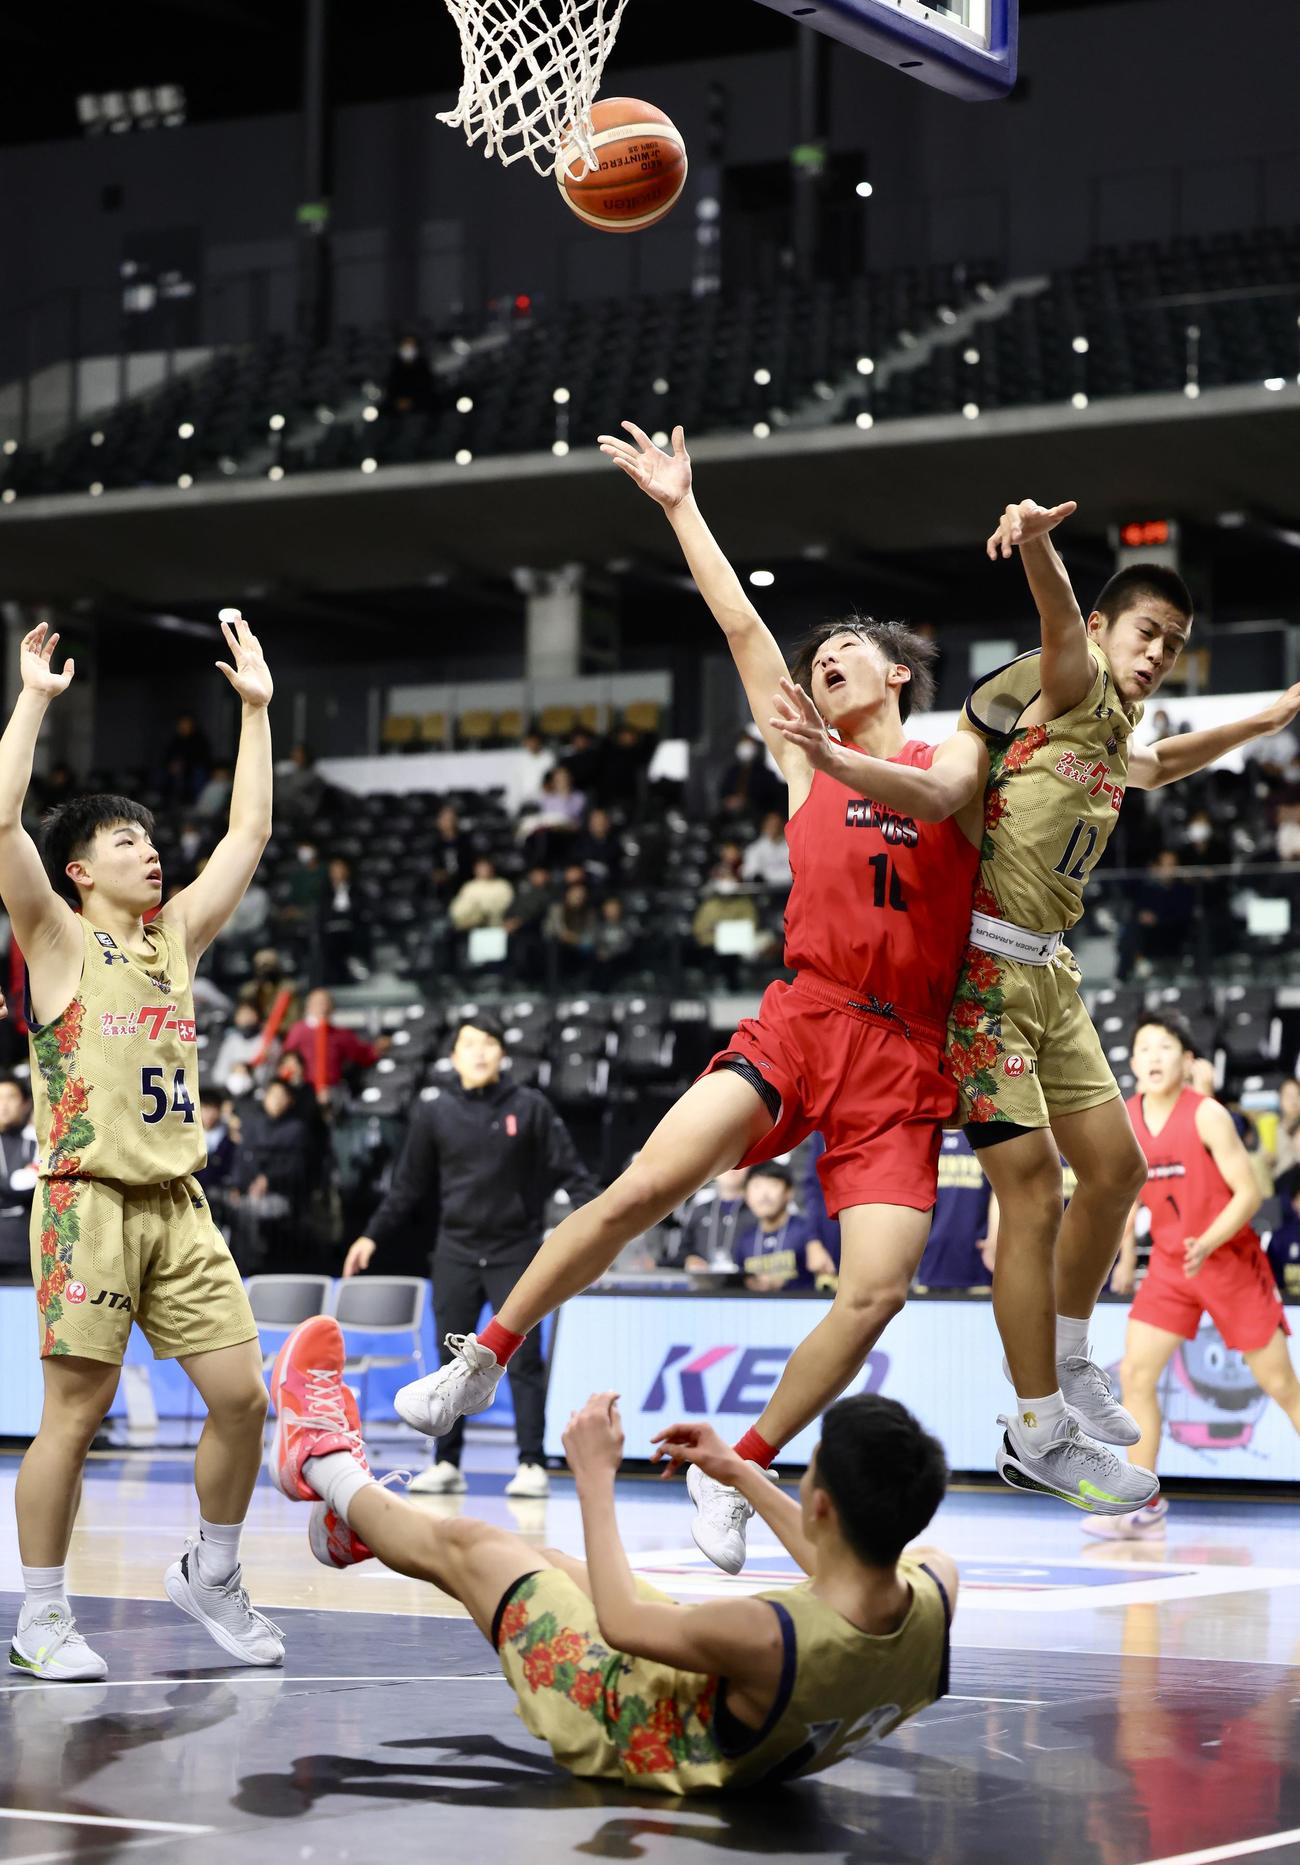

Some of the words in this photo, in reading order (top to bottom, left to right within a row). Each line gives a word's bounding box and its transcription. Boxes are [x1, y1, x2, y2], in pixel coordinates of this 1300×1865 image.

[1053, 817, 1099, 881] 12
[975, 928, 1014, 945] ARMOUR
[1015, 941, 1039, 953] UNDER
[142, 1067, 195, 1123] 54
[90, 1290, 132, 1312] JTA
[640, 1344, 890, 1414] KE
